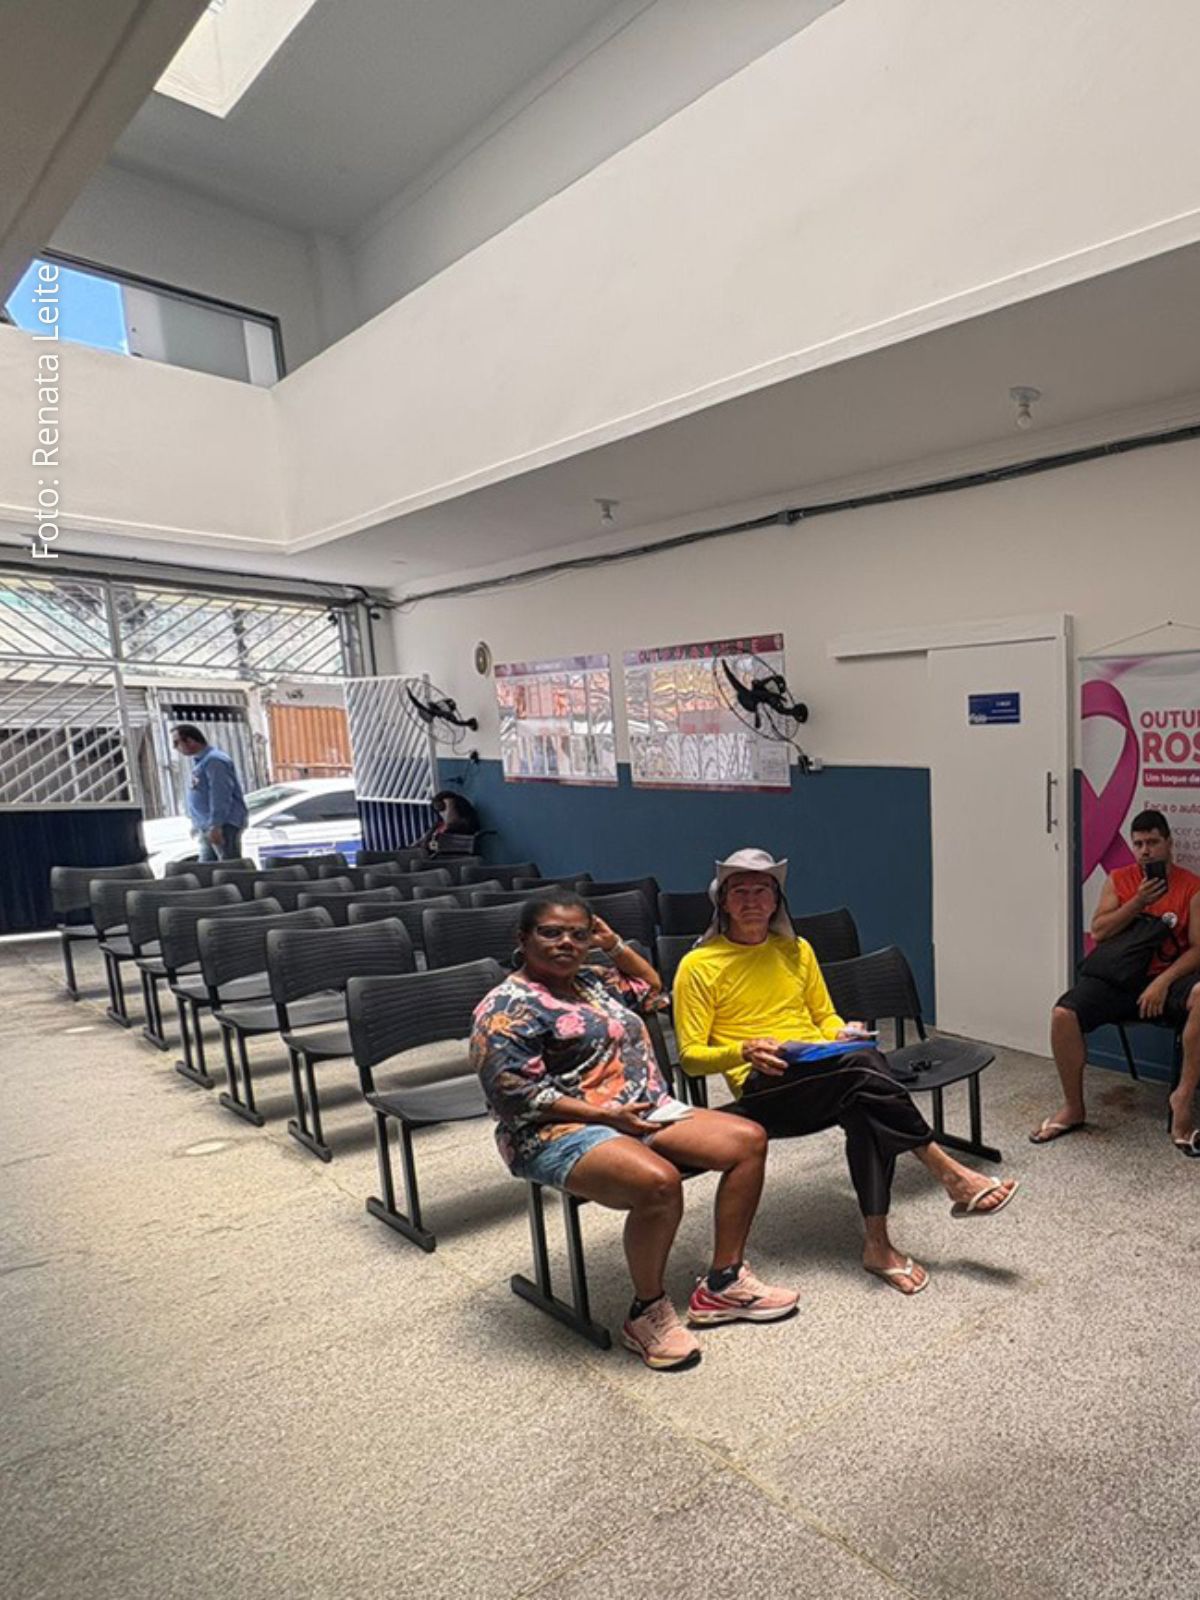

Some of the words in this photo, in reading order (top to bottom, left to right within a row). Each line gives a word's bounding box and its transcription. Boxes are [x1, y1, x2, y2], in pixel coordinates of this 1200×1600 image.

[1145, 773, 1160, 782] Um
[1161, 773, 1187, 784] toque
[1189, 773, 1200, 782] de
[1169, 805, 1177, 814] o
